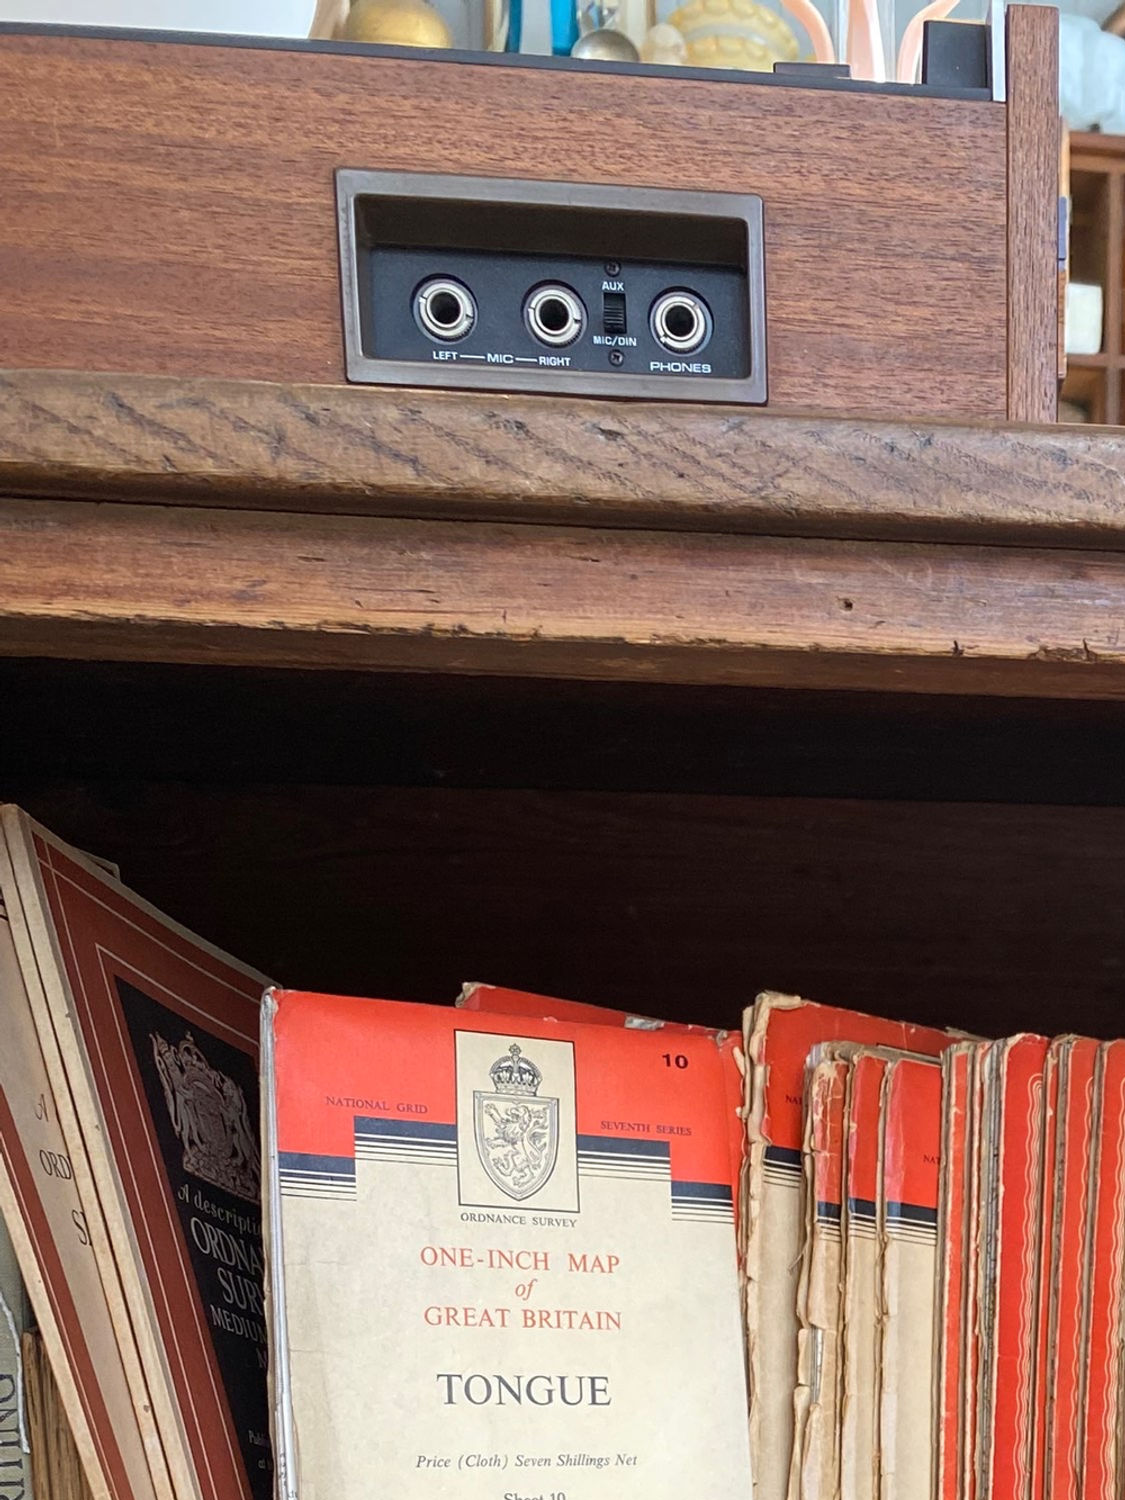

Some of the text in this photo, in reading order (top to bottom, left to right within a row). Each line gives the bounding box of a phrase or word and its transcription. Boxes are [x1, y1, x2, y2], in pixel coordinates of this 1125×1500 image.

[601, 281, 625, 291] AUX
[593, 335, 637, 347] MIC/DIN
[432, 351, 571, 367] LEFT MIC RIGHT
[650, 362, 711, 374] PHONES
[661, 1052, 689, 1070] 10
[325, 1095, 429, 1115] NATIONAL GRID
[600, 1119, 692, 1137] SEVENTH SERIES
[460, 1212, 578, 1229] ORDNANCE SURVEY
[189, 1216, 264, 1277] ORDNA
[419, 1245, 620, 1274] ONE-INCH MAP
[514, 1277, 537, 1301] of
[423, 1305, 622, 1331] GREAT BRITAIN
[436, 1372, 612, 1407] TONGUE
[416, 1453, 638, 1470] Price (Cloth) Seven Shillings Net
